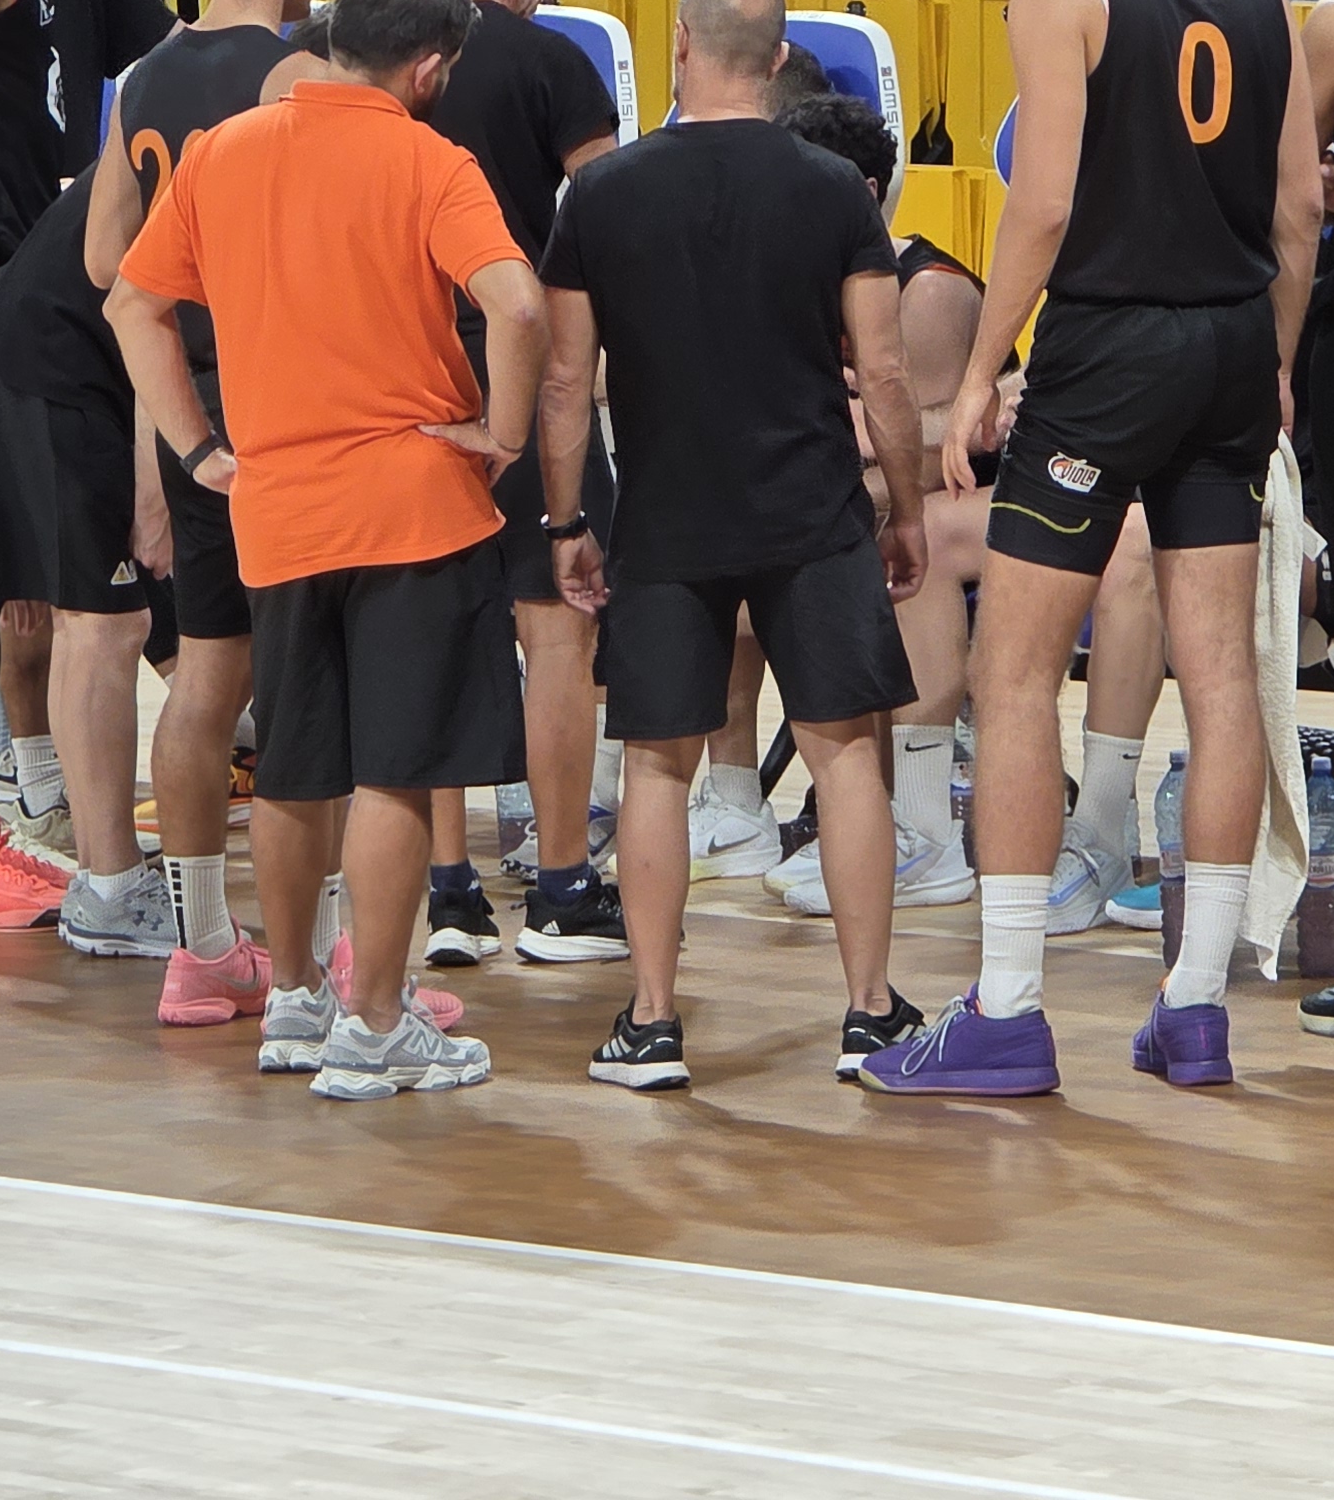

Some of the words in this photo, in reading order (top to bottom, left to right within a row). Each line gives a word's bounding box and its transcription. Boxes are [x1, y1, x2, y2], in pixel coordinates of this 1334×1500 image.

[1178, 21, 1233, 144] 0
[131, 128, 207, 217] 2
[1061, 463, 1097, 487] VIOLA
